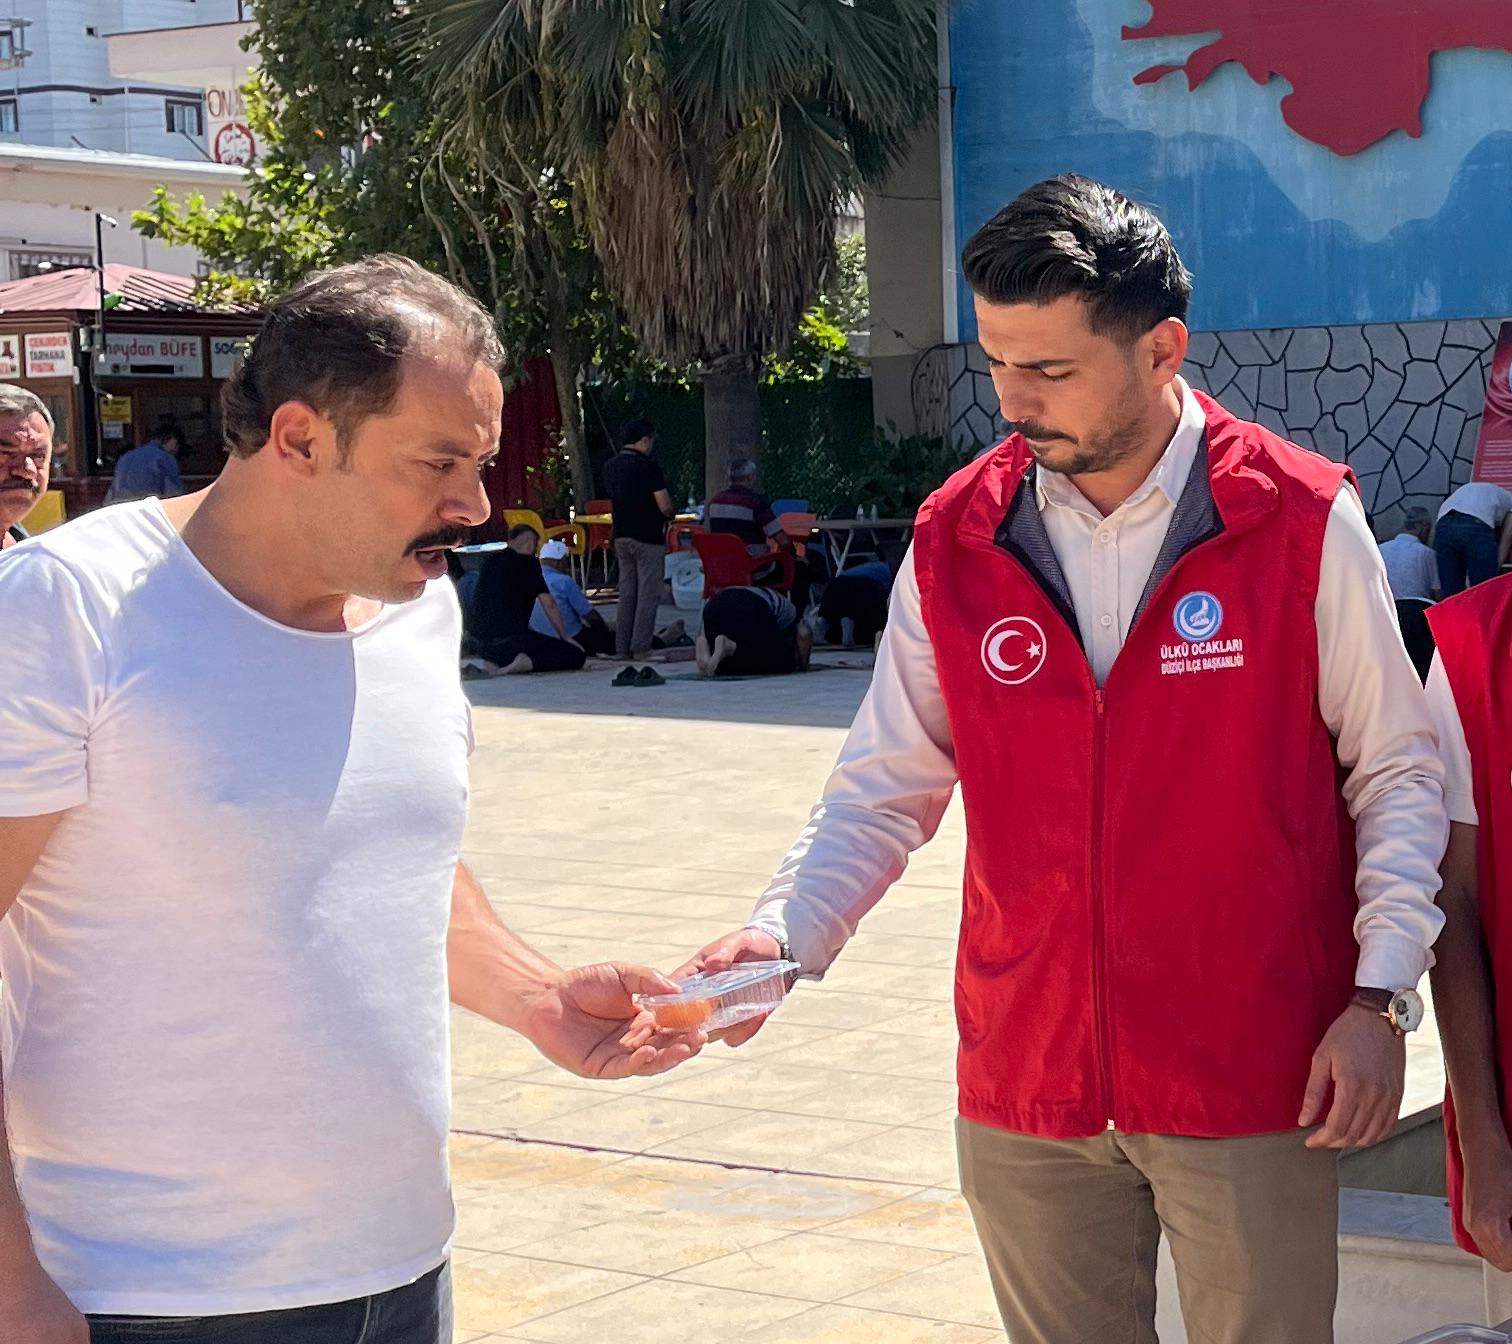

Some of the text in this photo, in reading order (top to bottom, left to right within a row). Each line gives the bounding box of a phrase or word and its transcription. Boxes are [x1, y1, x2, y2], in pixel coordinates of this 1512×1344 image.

[160, 338, 197, 357] BÜFE
[1160, 638, 1243, 659] ÜLKÜ OCAKLARI
